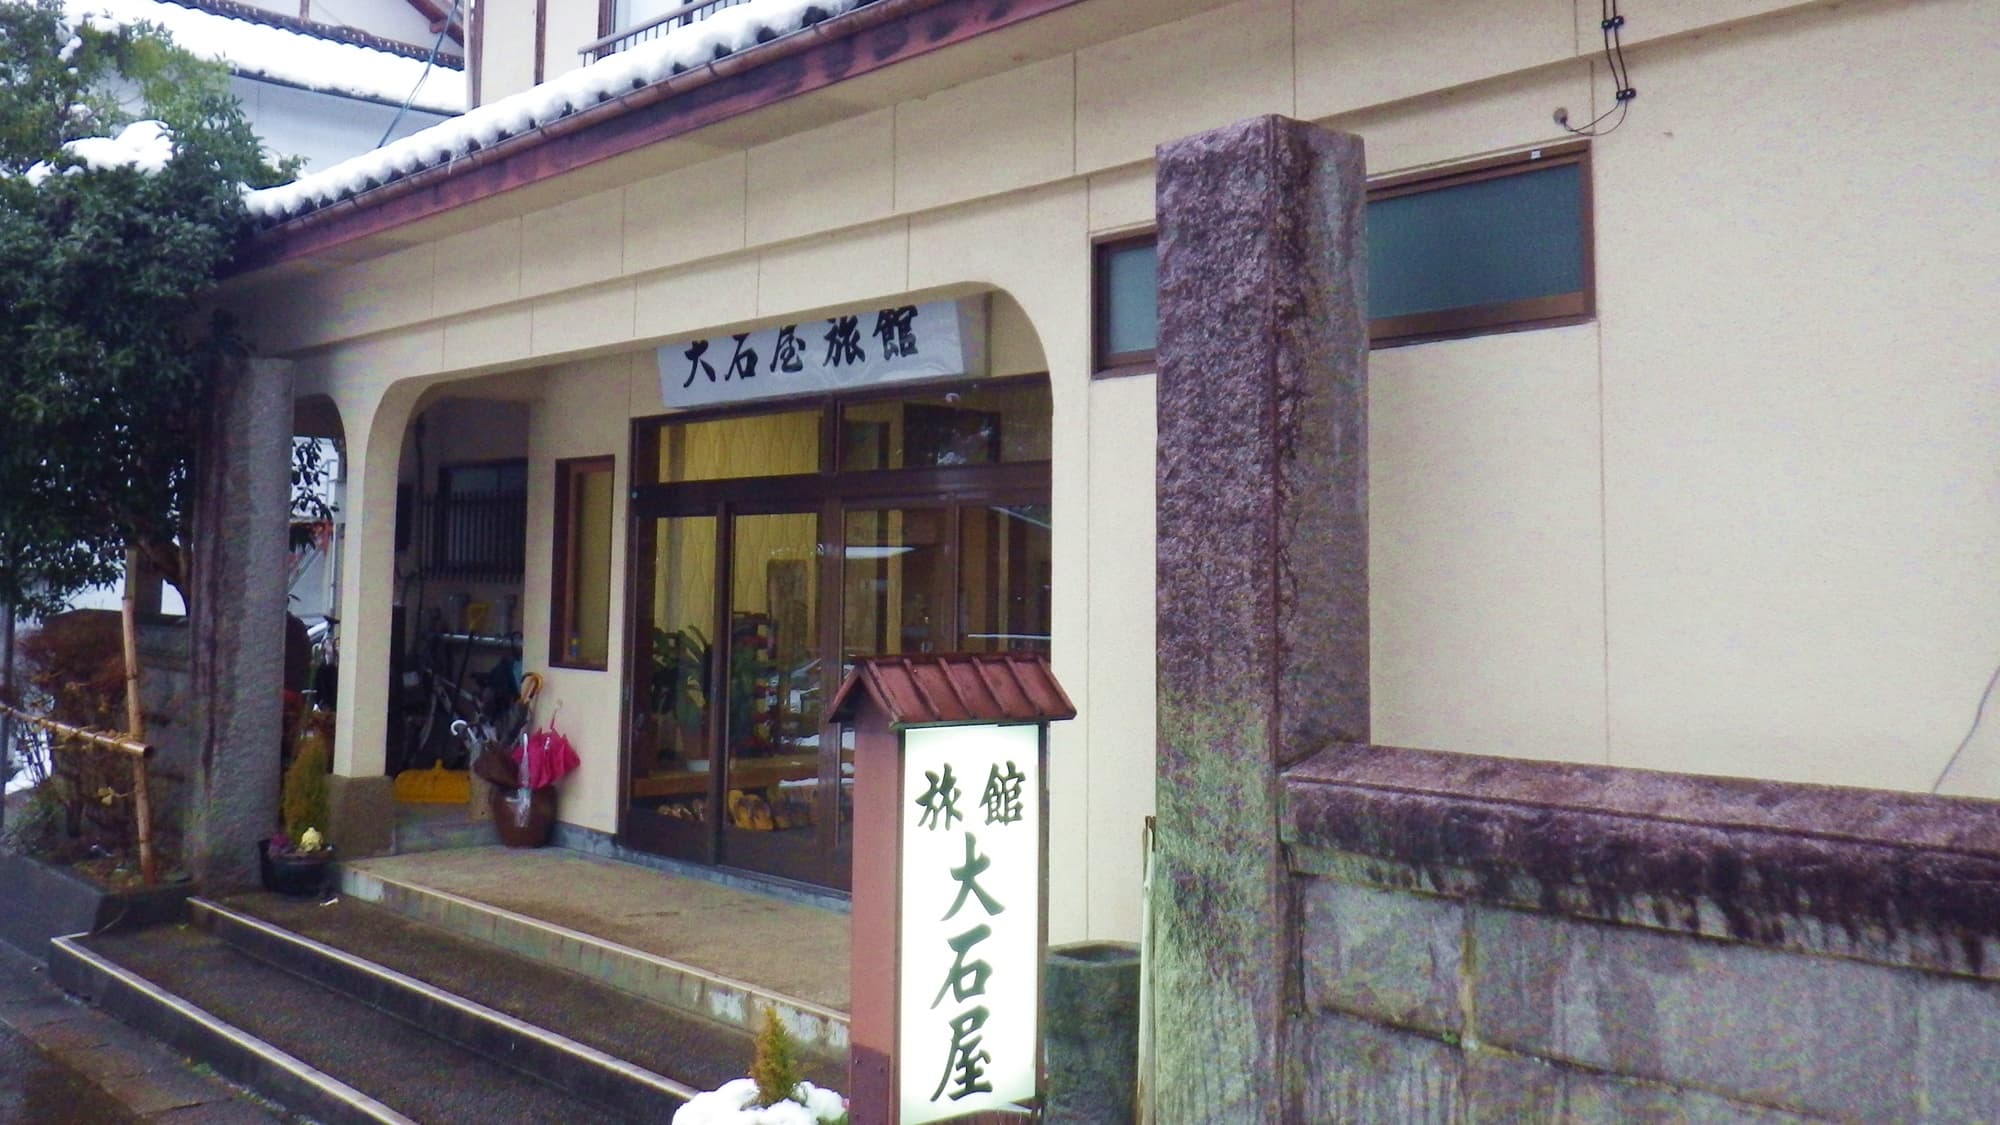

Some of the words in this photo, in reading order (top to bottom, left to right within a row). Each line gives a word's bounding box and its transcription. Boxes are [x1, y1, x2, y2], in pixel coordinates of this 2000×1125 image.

[683, 304, 920, 388] 大石屋旅館
[914, 759, 1026, 832] 旅館
[929, 830, 1007, 1104] 大石屋
